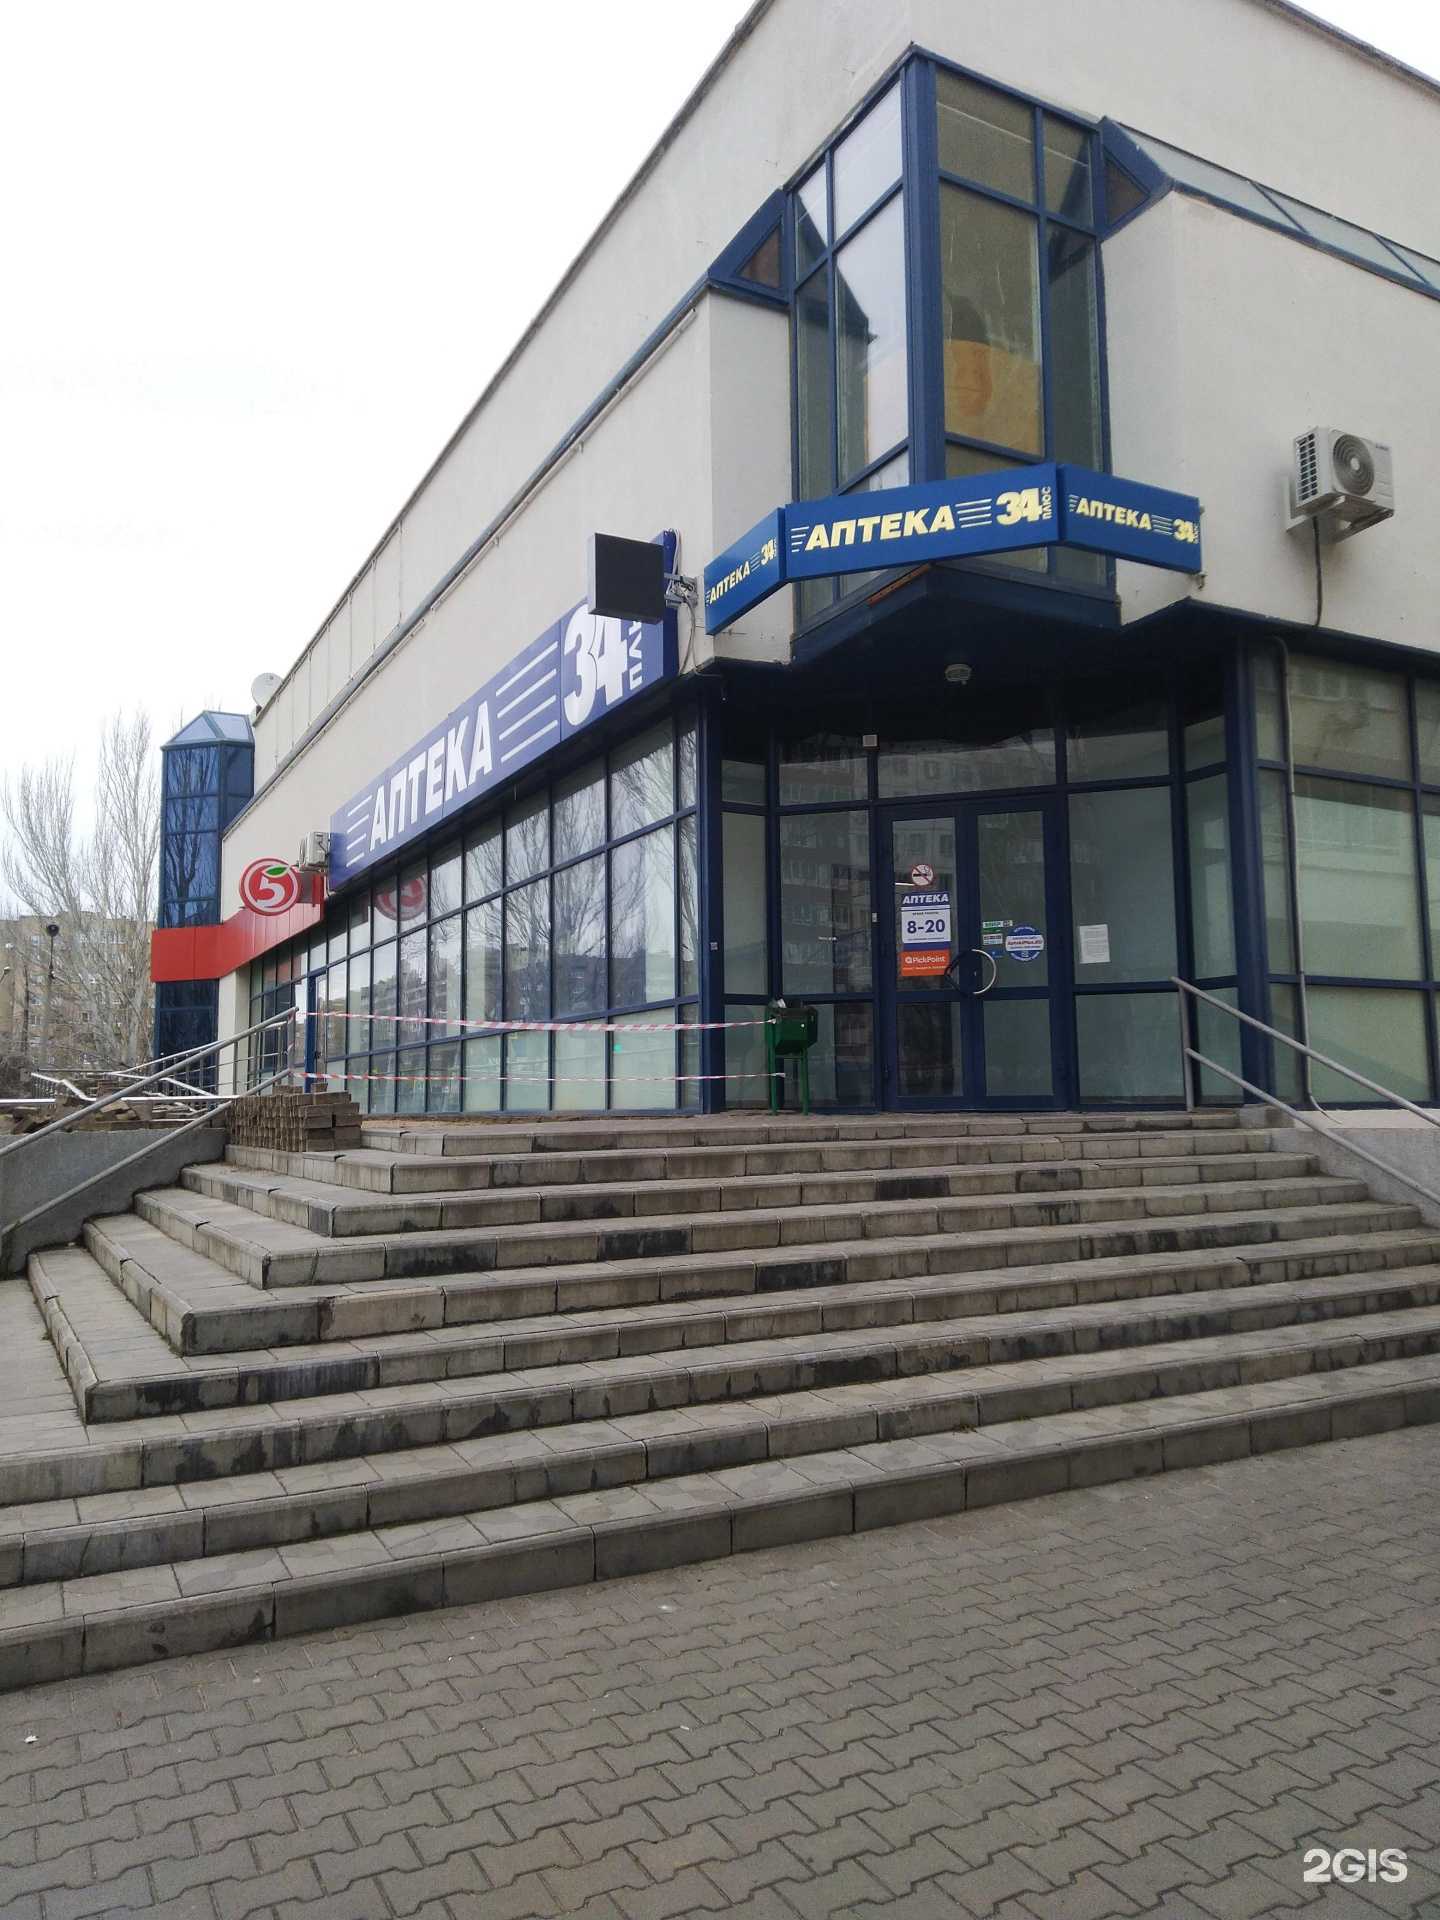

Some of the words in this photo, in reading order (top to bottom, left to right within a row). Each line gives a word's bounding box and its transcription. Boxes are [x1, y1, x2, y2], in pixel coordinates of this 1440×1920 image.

[804, 504, 956, 551] АПТЕКА
[996, 487, 1043, 526] 34
[1042, 486, 1053, 520] ПЛЮС
[1076, 497, 1152, 530] АПТЕКА
[1173, 518, 1195, 543] 34
[709, 560, 751, 605] АПТЕКА
[761, 539, 775, 565] 34
[628, 620, 643, 690] ПЛ
[370, 700, 493, 852] АПТЕКА
[563, 604, 628, 726] 34
[902, 894, 949, 904] АПТЕКА
[907, 919, 945, 934] 8-20
